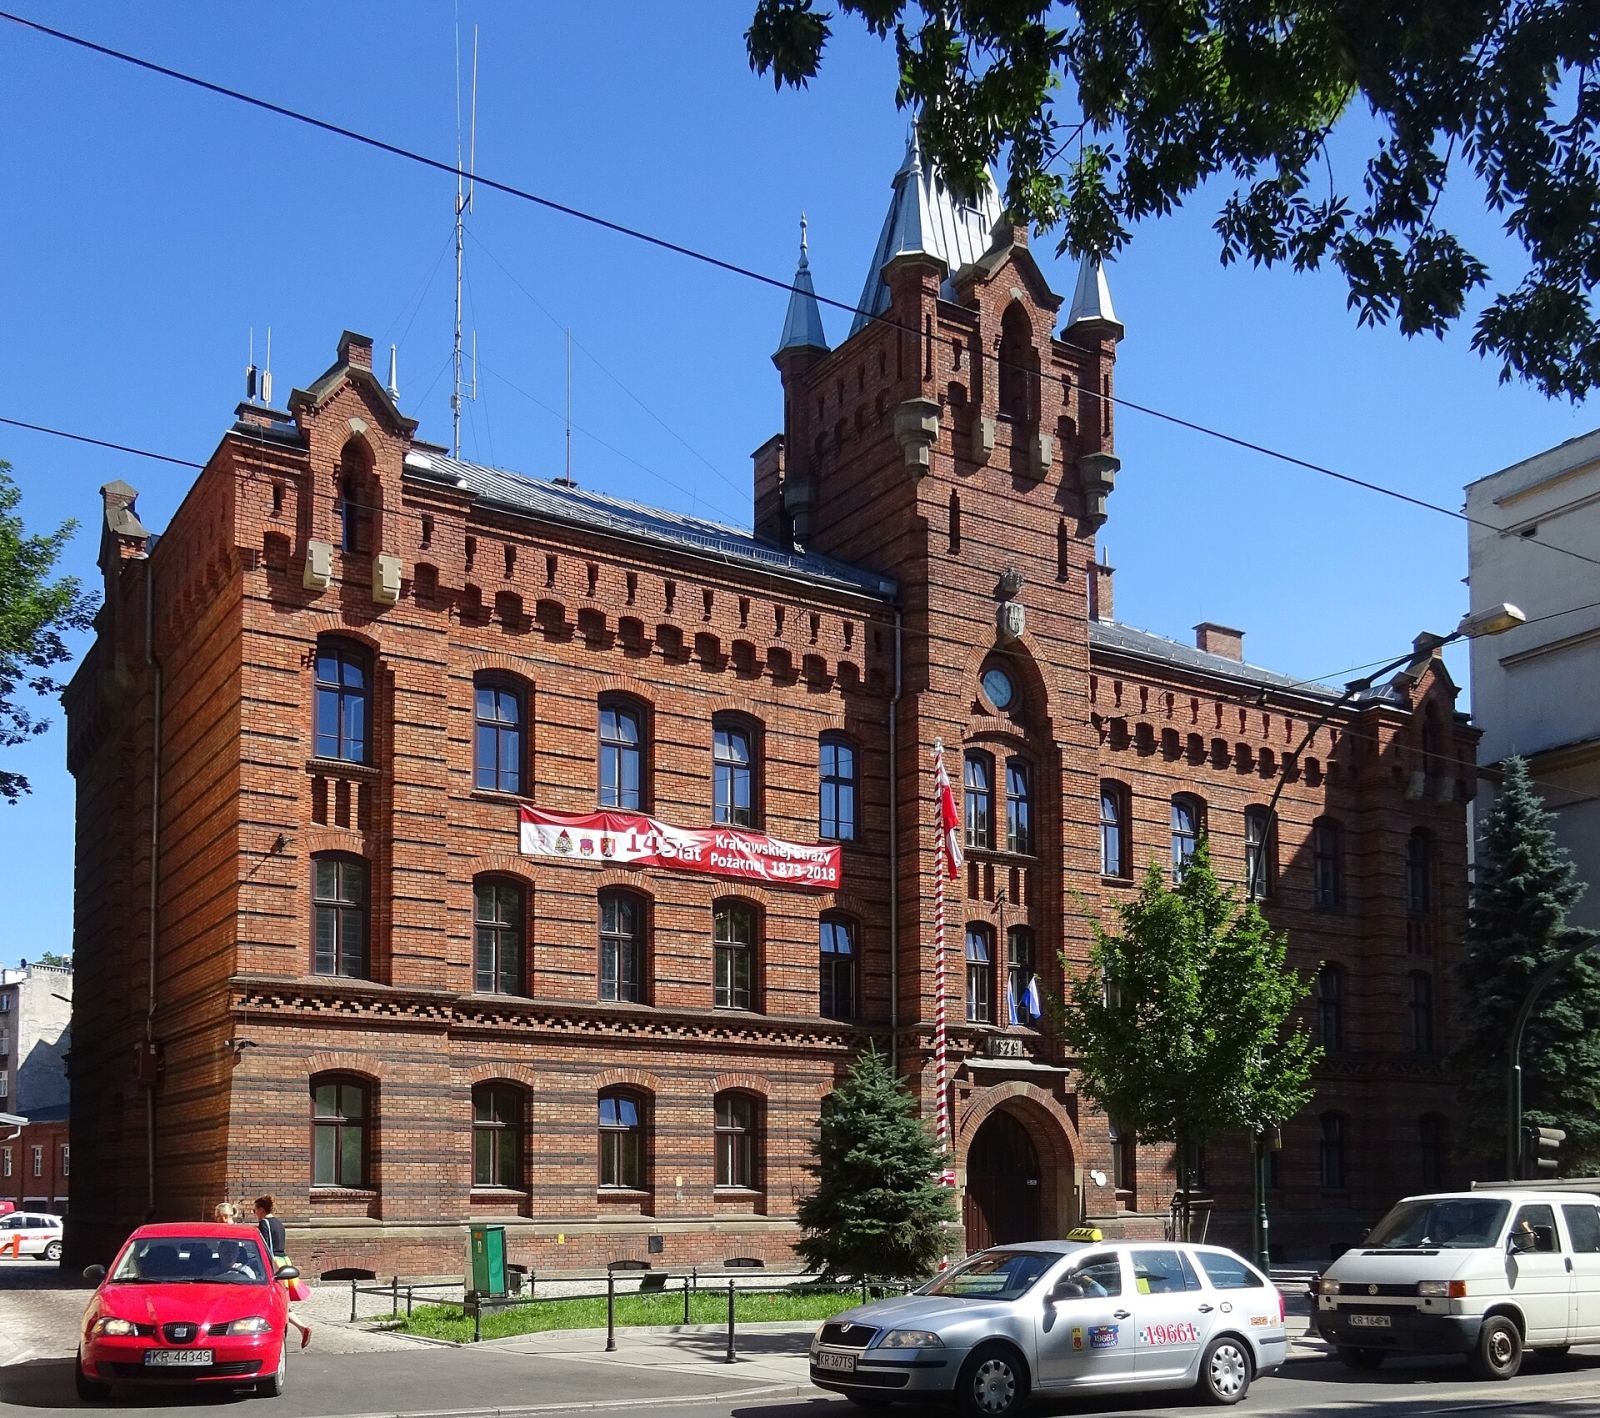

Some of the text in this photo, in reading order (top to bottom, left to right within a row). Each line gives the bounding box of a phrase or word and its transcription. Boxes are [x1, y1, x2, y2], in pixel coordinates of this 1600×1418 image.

[715, 834, 791, 861] Krakowskiej
[710, 851, 836, 881] Pożarnej 1873-2018
[1070, 1228, 1095, 1237] TAXI
[1352, 1316, 1363, 1325] KR
[1146, 1321, 1197, 1345] 19661
[152, 1351, 211, 1362] KR 44349
[820, 1354, 853, 1369] KR 367TS
